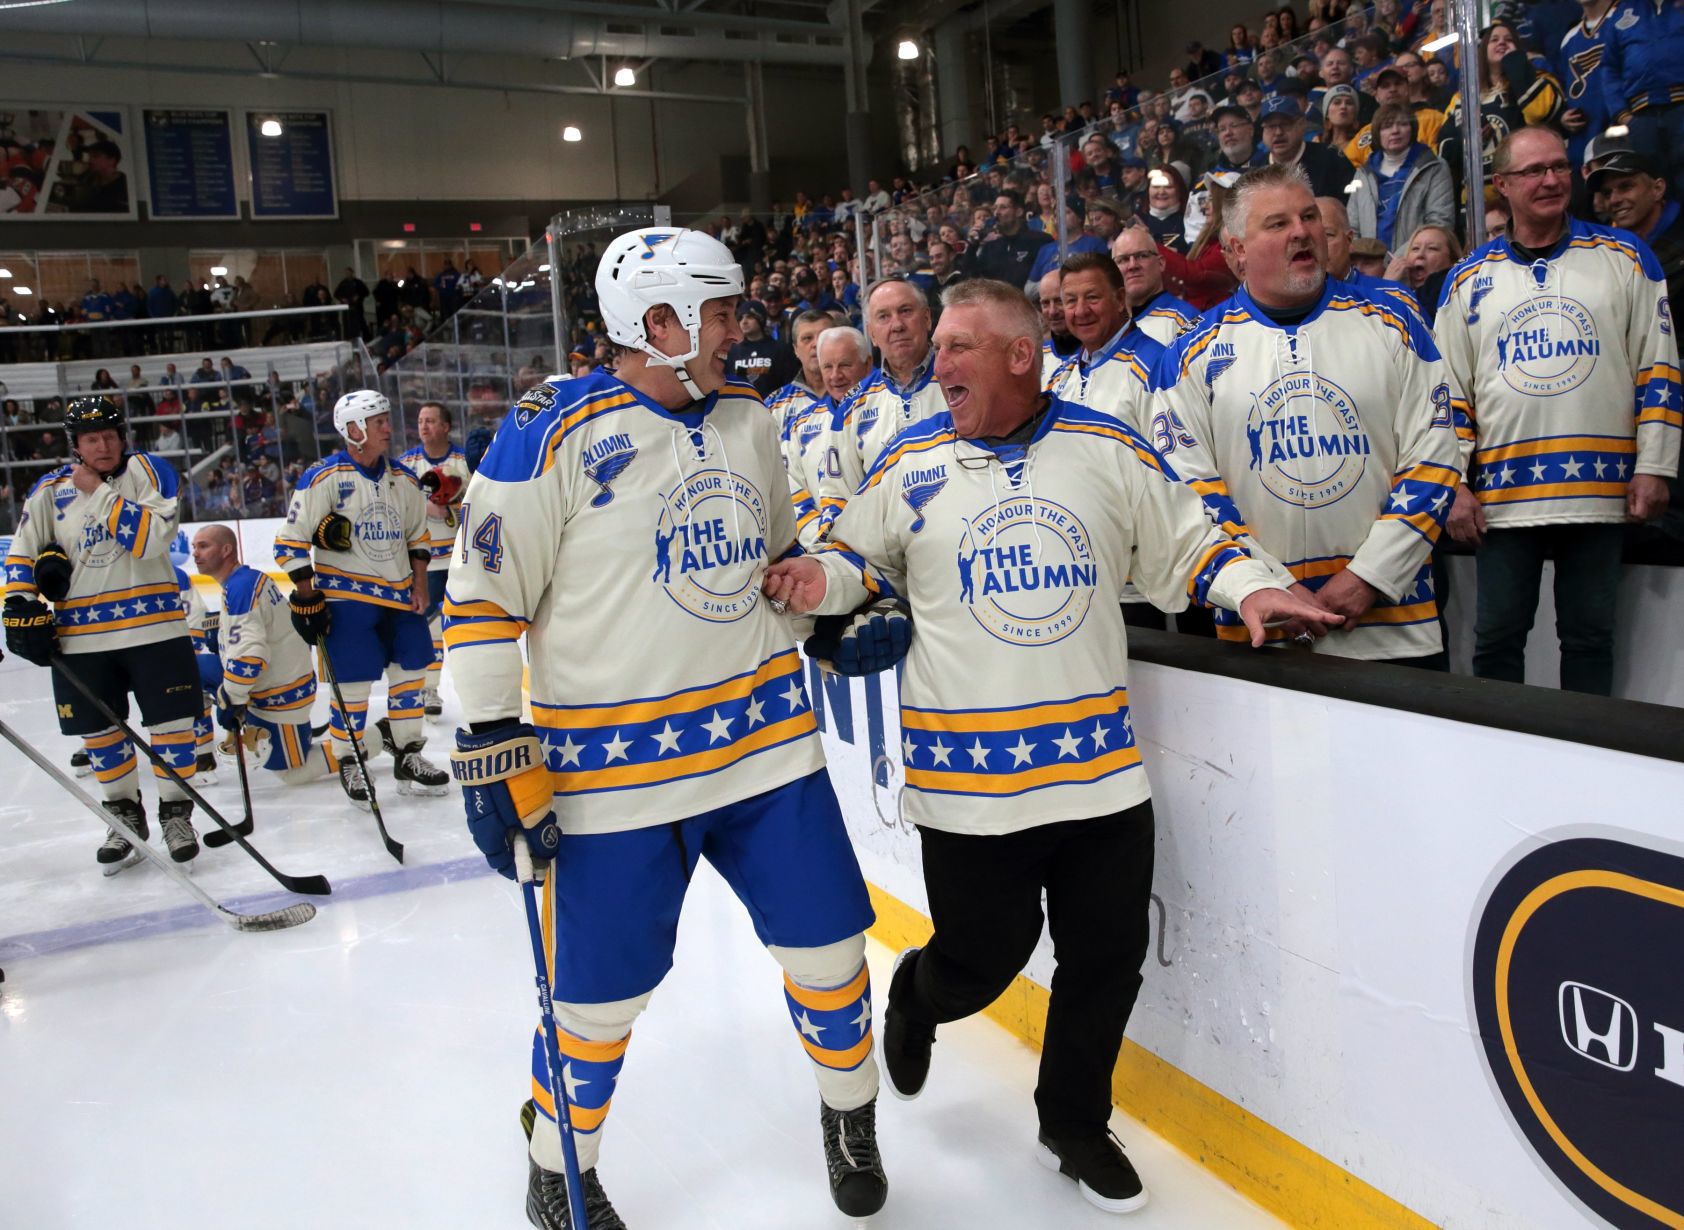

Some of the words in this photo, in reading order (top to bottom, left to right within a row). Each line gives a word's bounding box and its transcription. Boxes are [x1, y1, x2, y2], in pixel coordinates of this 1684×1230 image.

[1512, 327, 1549, 347] THE
[1576, 312, 1593, 336] PAST
[1210, 343, 1236, 358] MNI
[1511, 339, 1600, 364] ALUMNI
[1523, 381, 1552, 390] SINCE
[1264, 378, 1310, 408] HONOUR
[1335, 399, 1359, 431] PAST
[1266, 415, 1309, 440] THE
[582, 433, 635, 468] ALUMNI
[1268, 434, 1371, 464] ALUMNI
[674, 477, 722, 512] HONOUR
[1319, 481, 1343, 499] 1999
[364, 521, 383, 531] THE
[678, 518, 727, 548] THE
[977, 504, 1034, 536] HONOUR
[1039, 506, 1068, 527] THE
[1066, 525, 1090, 560] PAST
[680, 537, 768, 574] ALUMN
[979, 544, 1034, 571] THE
[982, 564, 1097, 596] ALUMNI
[703, 601, 738, 613] SINCE
[743, 585, 760, 607] 1999
[228, 625, 242, 645] 5
[1002, 623, 1041, 637] SINCE
[1048, 615, 1072, 634] 1999
